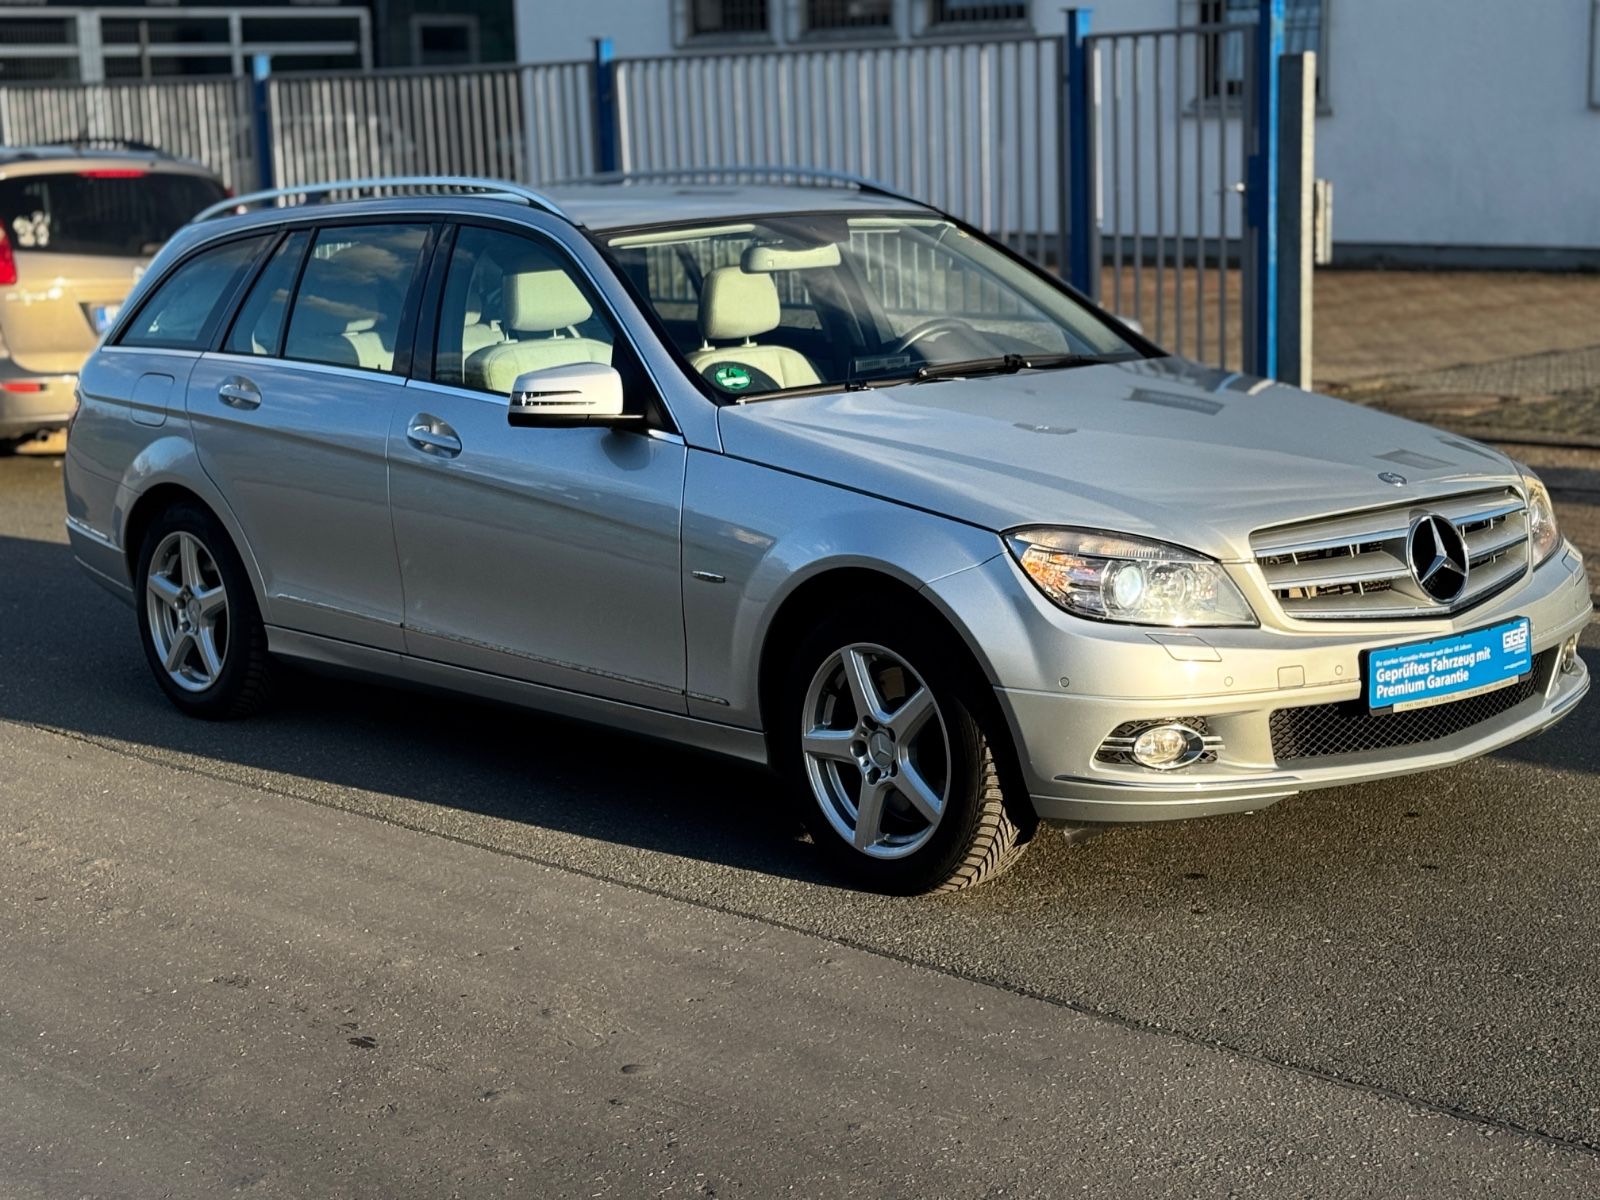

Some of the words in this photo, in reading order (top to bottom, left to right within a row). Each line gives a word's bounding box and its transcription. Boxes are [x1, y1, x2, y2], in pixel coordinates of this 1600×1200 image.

[1376, 661, 1430, 684] Geprüftes
[1431, 652, 1475, 673] Fahrzeug
[1476, 646, 1491, 663] mit
[1376, 679, 1425, 699] Premium
[1427, 668, 1469, 689] Garantie
